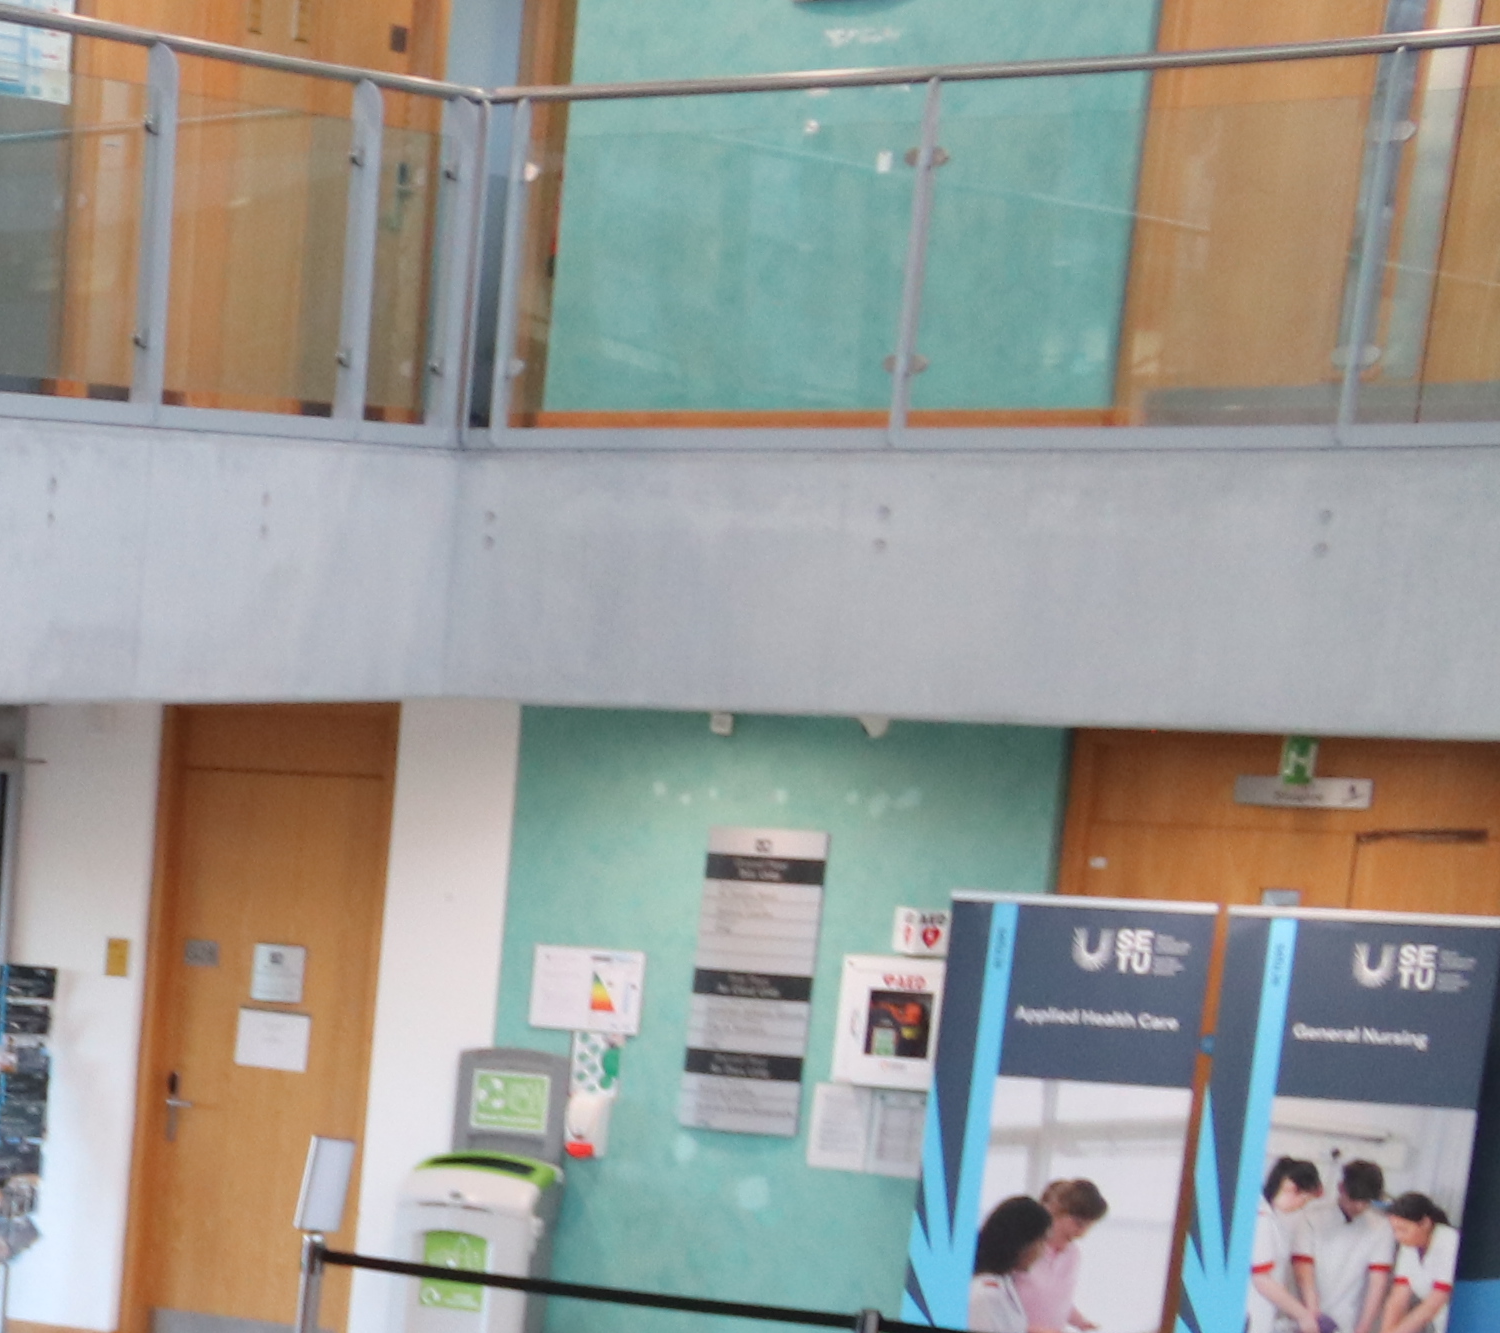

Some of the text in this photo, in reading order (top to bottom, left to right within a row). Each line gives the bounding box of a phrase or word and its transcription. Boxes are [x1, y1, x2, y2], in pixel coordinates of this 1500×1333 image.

[1115, 928, 1155, 950] SE
[1116, 951, 1152, 975] TU
[1399, 943, 1438, 967] SE
[1398, 967, 1436, 991] TU
[1013, 1005, 1181, 1032] Applied Health Care
[1292, 1022, 1429, 1052] General Nursing
